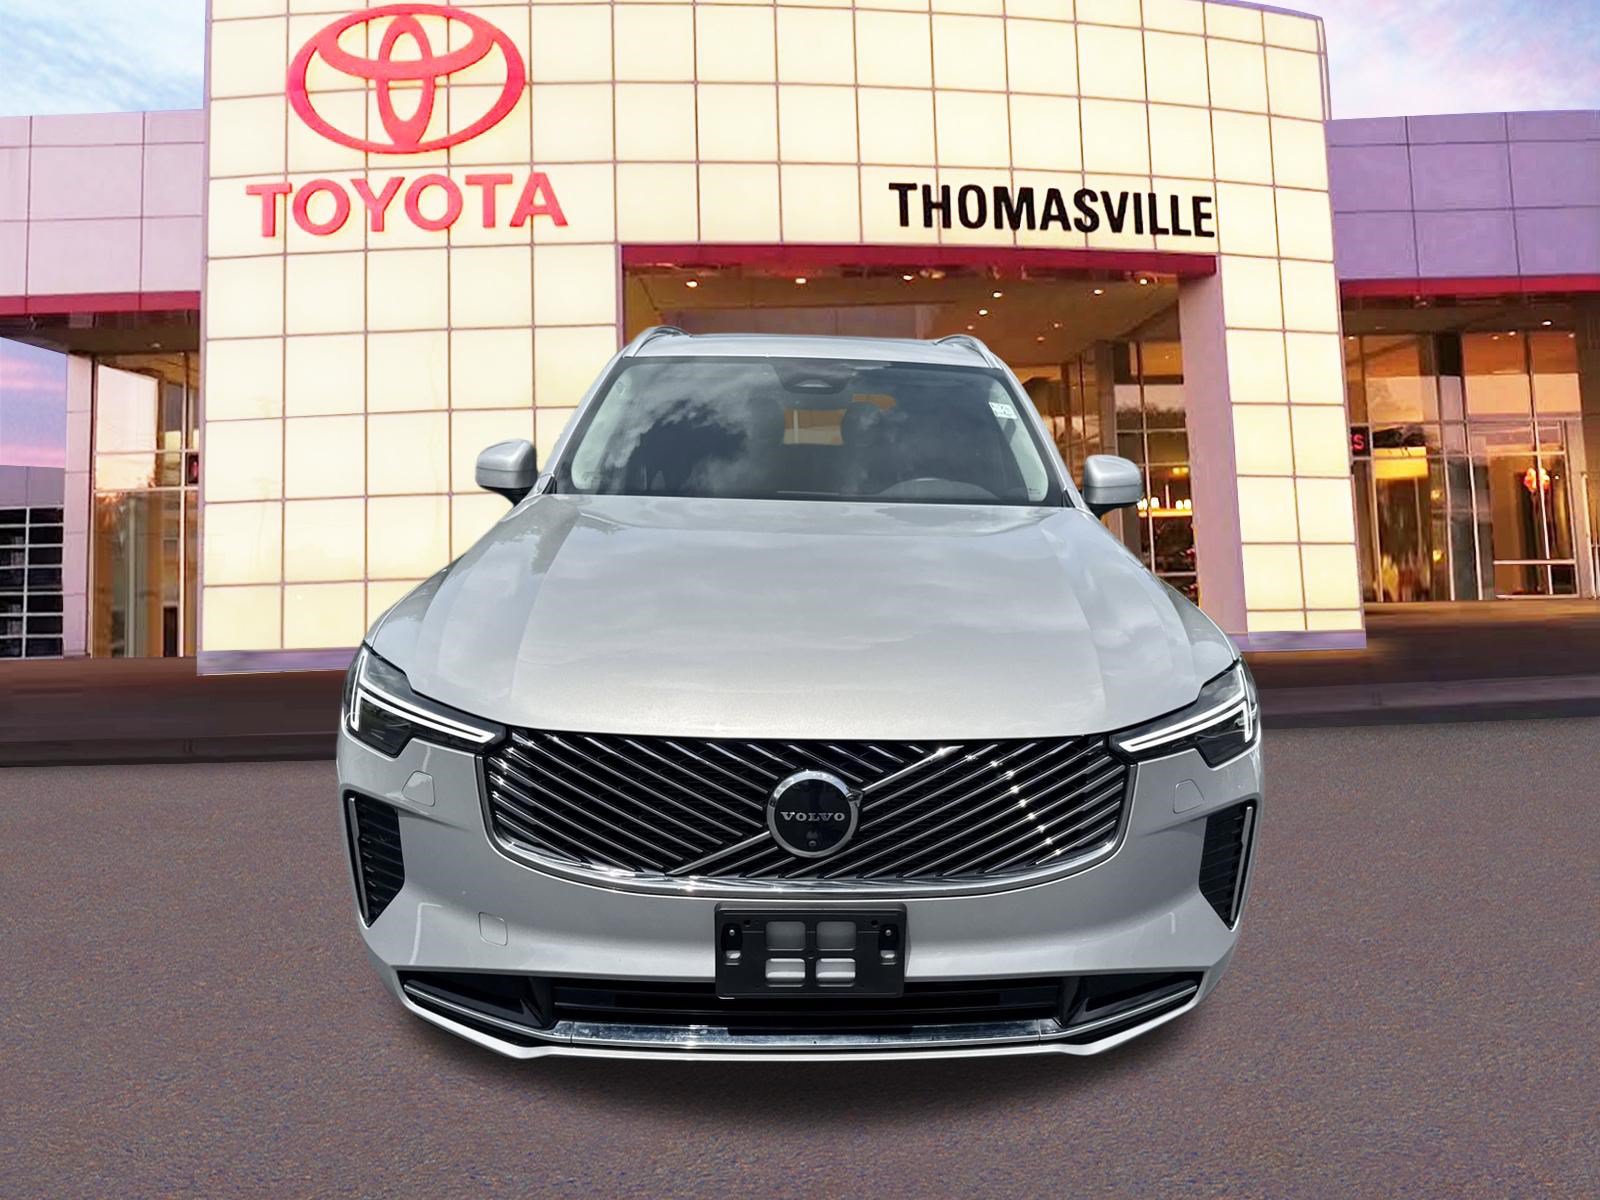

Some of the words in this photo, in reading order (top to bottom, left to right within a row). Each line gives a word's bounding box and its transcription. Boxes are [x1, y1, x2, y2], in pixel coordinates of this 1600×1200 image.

[246, 172, 568, 237] TOYOTA
[889, 182, 1215, 237] THOMASVILLE
[780, 811, 845, 821] VOLVO
